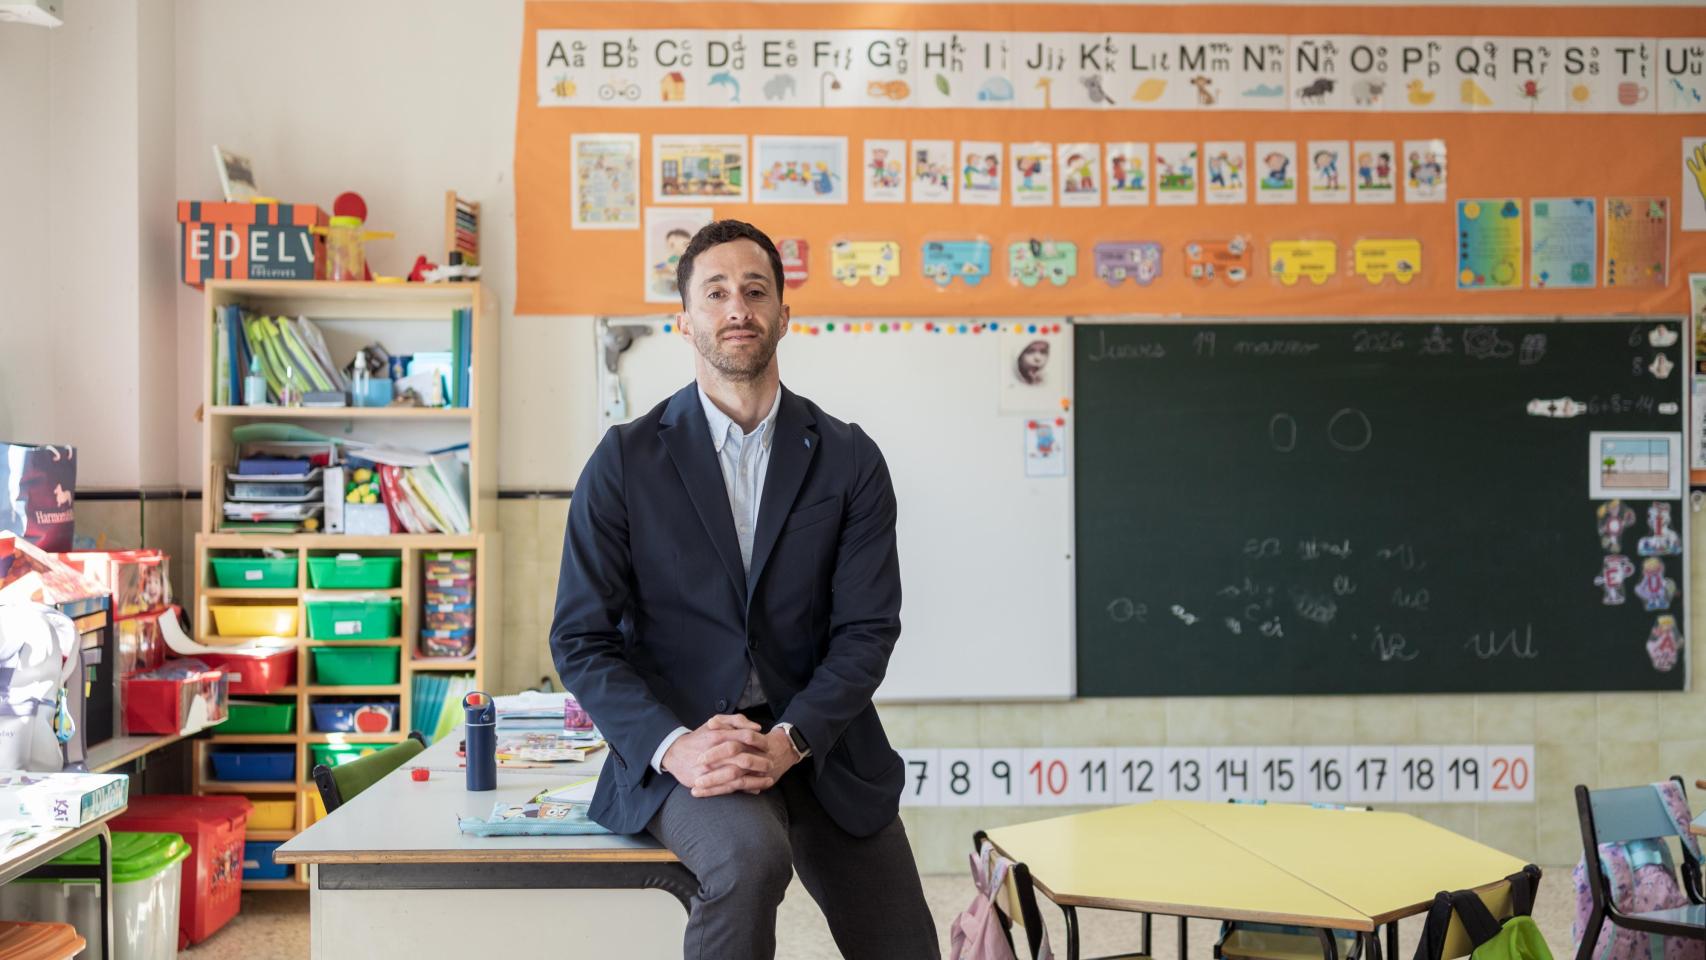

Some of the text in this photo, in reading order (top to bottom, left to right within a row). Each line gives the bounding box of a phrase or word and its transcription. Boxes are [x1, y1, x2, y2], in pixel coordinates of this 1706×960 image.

[547, 39, 1688, 75] A B C D E F G H I J K L M N Ñ O P Q R S T U
[908, 757, 1528, 795] 7 8 9 10 11 12 13 14 15 16 17 18 19 20
